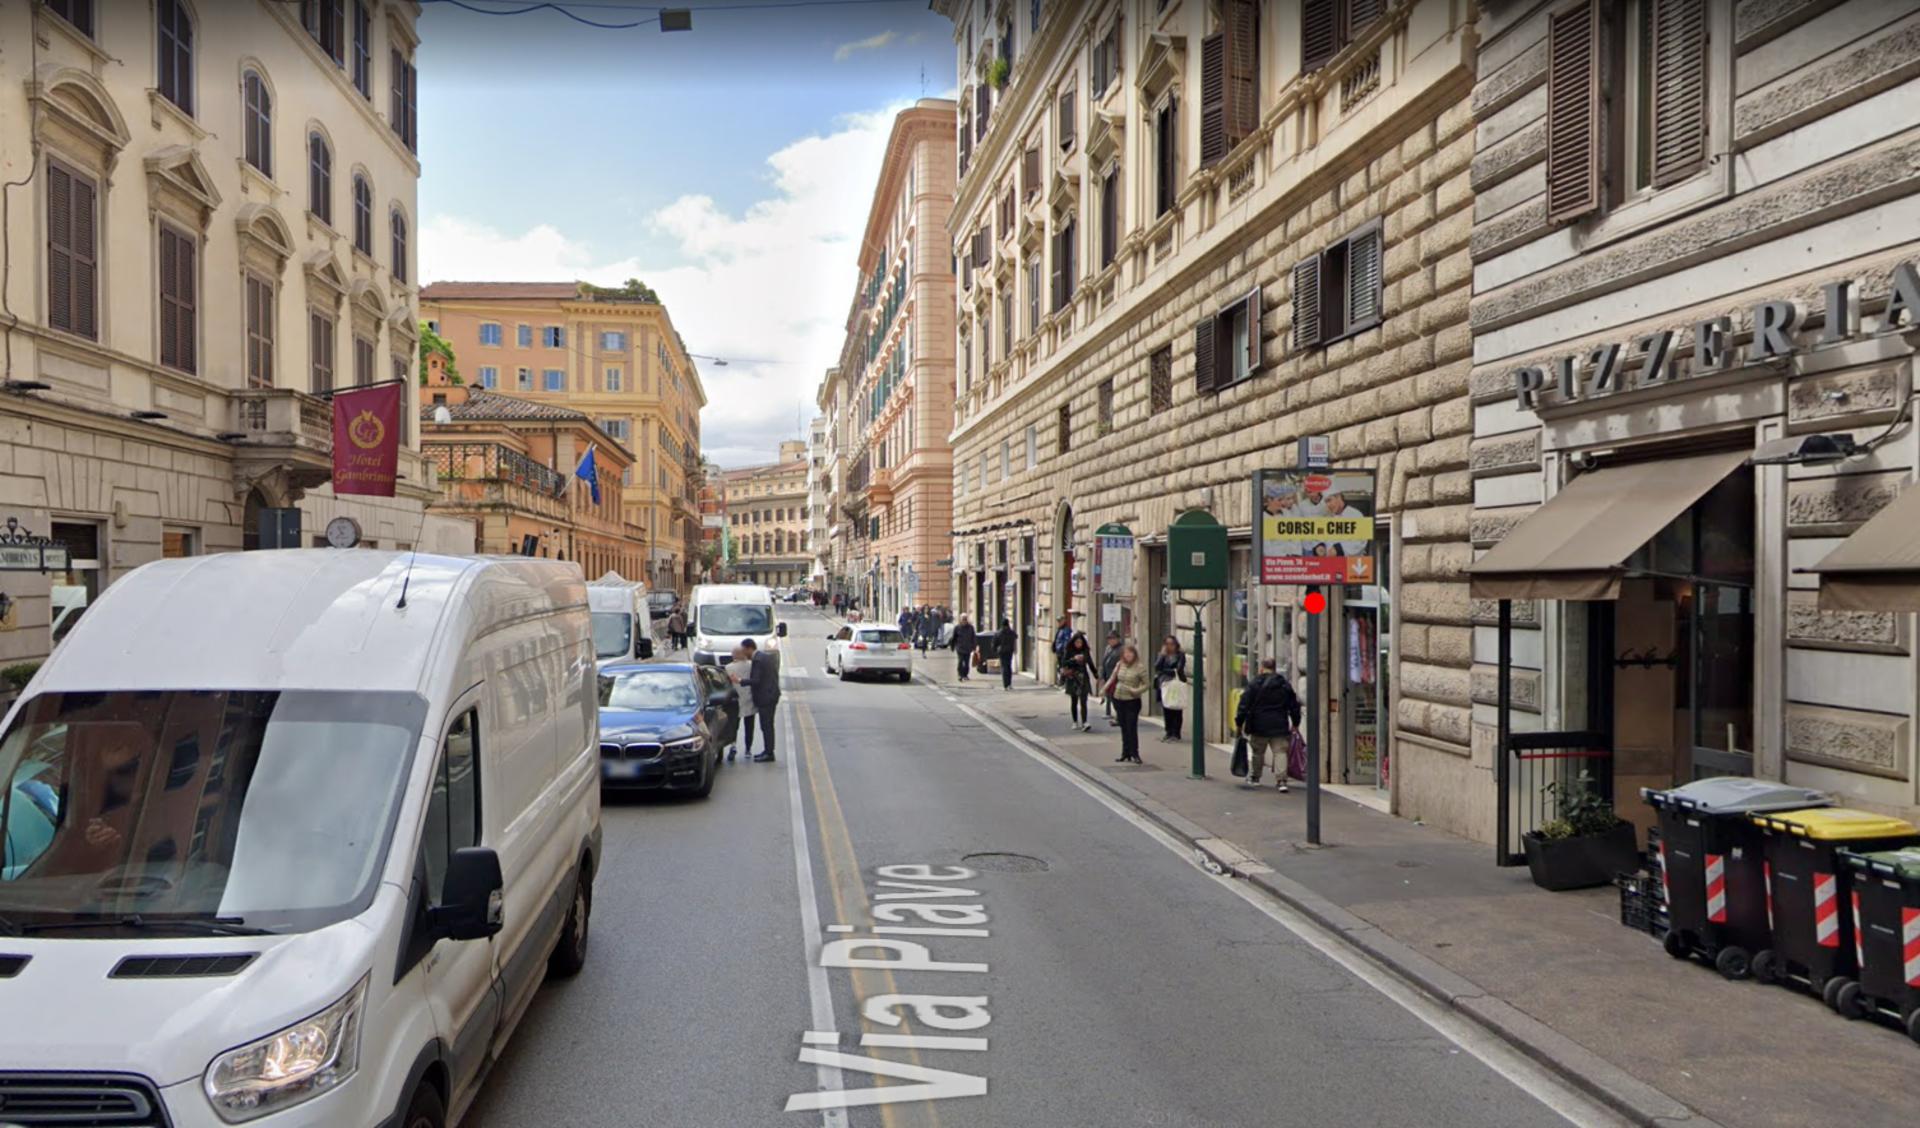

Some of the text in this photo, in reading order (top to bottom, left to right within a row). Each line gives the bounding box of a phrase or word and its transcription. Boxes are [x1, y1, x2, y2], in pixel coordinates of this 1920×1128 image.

[1515, 263, 1920, 411] PIZZERIA
[349, 454, 384, 466] Hotel
[1277, 522, 1314, 534] CORSI
[1327, 522, 1357, 534] CHEF
